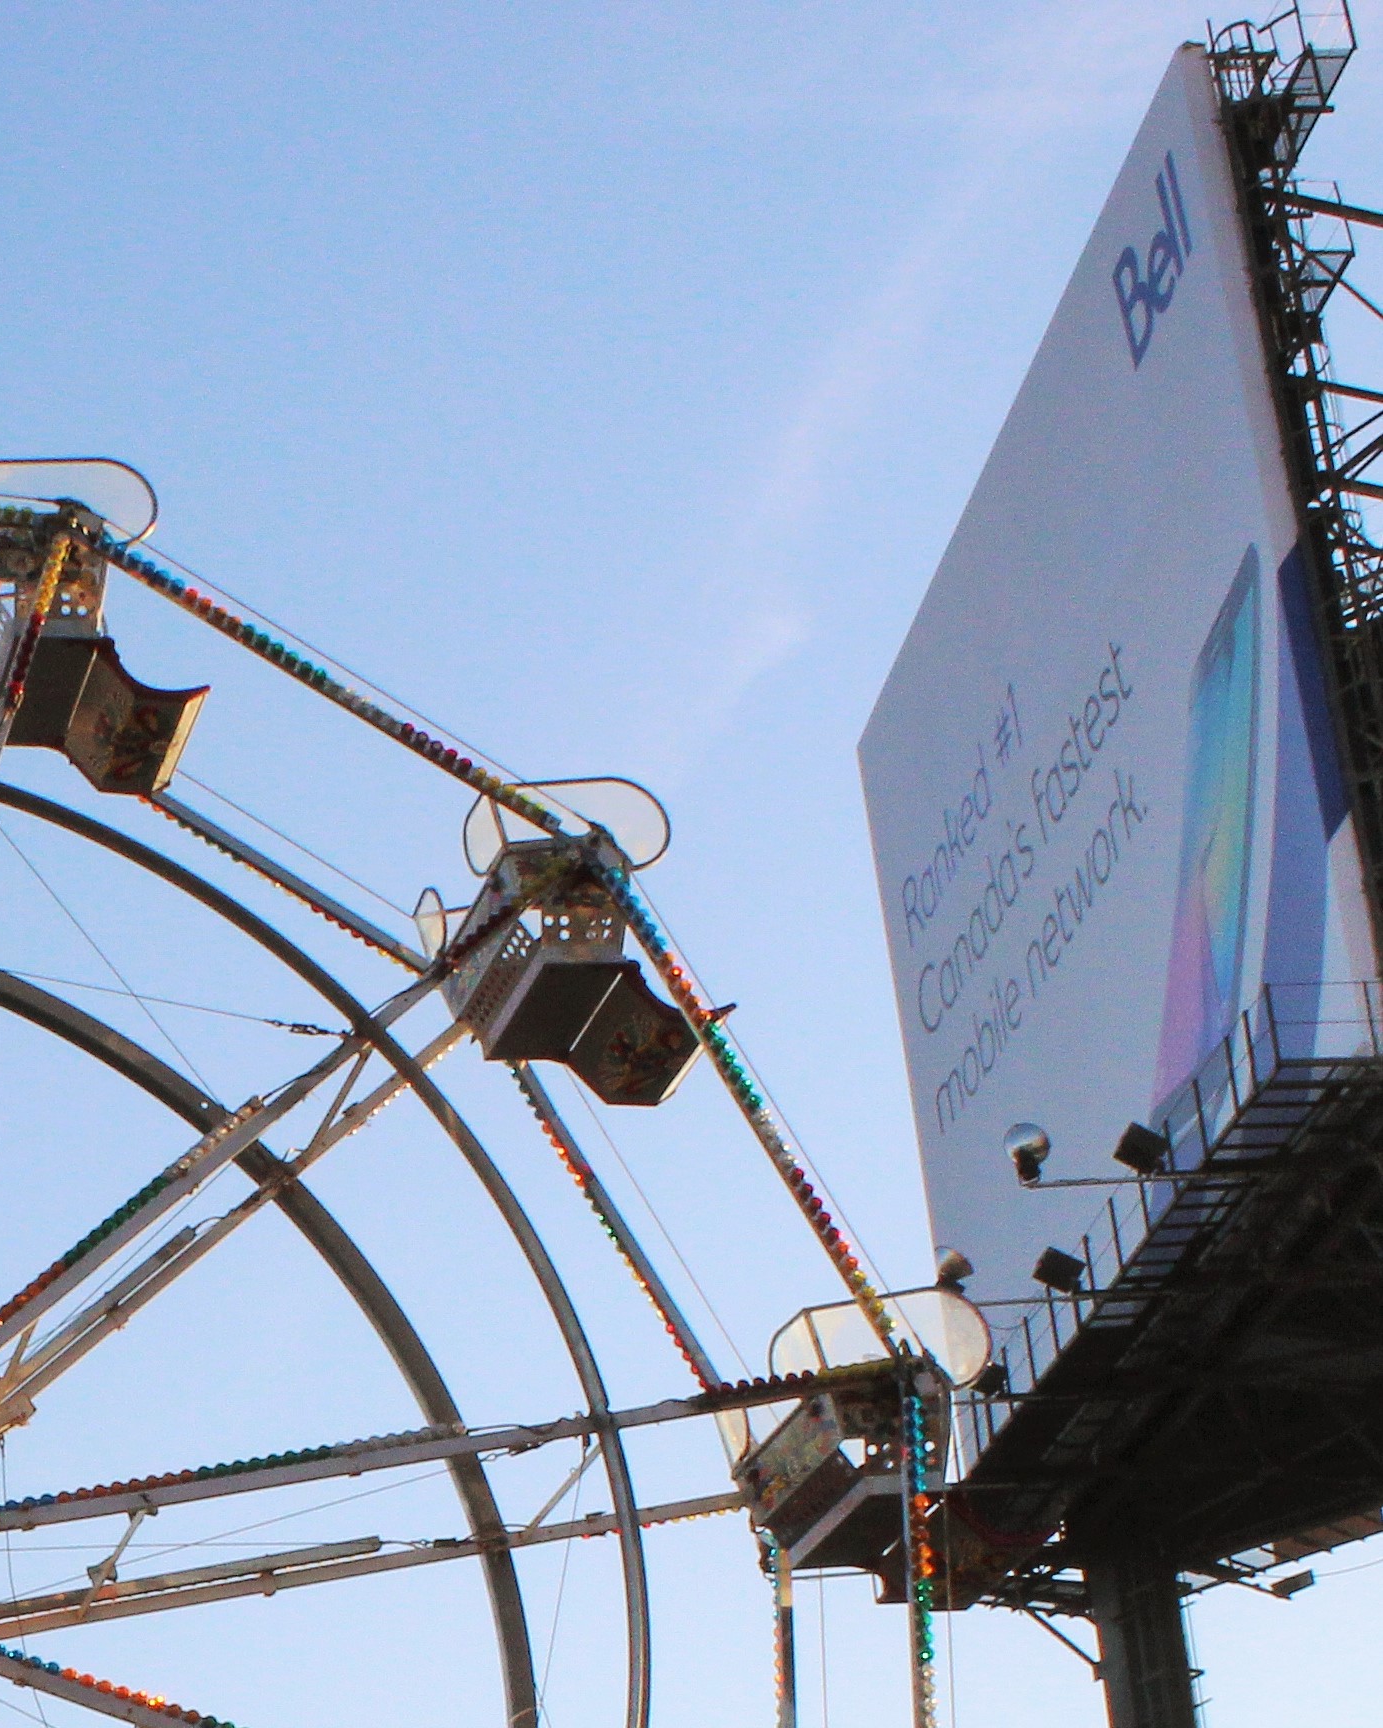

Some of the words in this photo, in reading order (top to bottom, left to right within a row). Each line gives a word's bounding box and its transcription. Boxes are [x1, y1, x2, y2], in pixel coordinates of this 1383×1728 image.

[1112, 150, 1192, 372] Bell
[902, 741, 991, 948] Ranked
[995, 682, 1022, 767] #1
[918, 820, 1034, 1034] Canada's
[1031, 641, 1133, 844] fastest
[936, 977, 1022, 1136] mobile
[1026, 769, 1147, 999] network.
